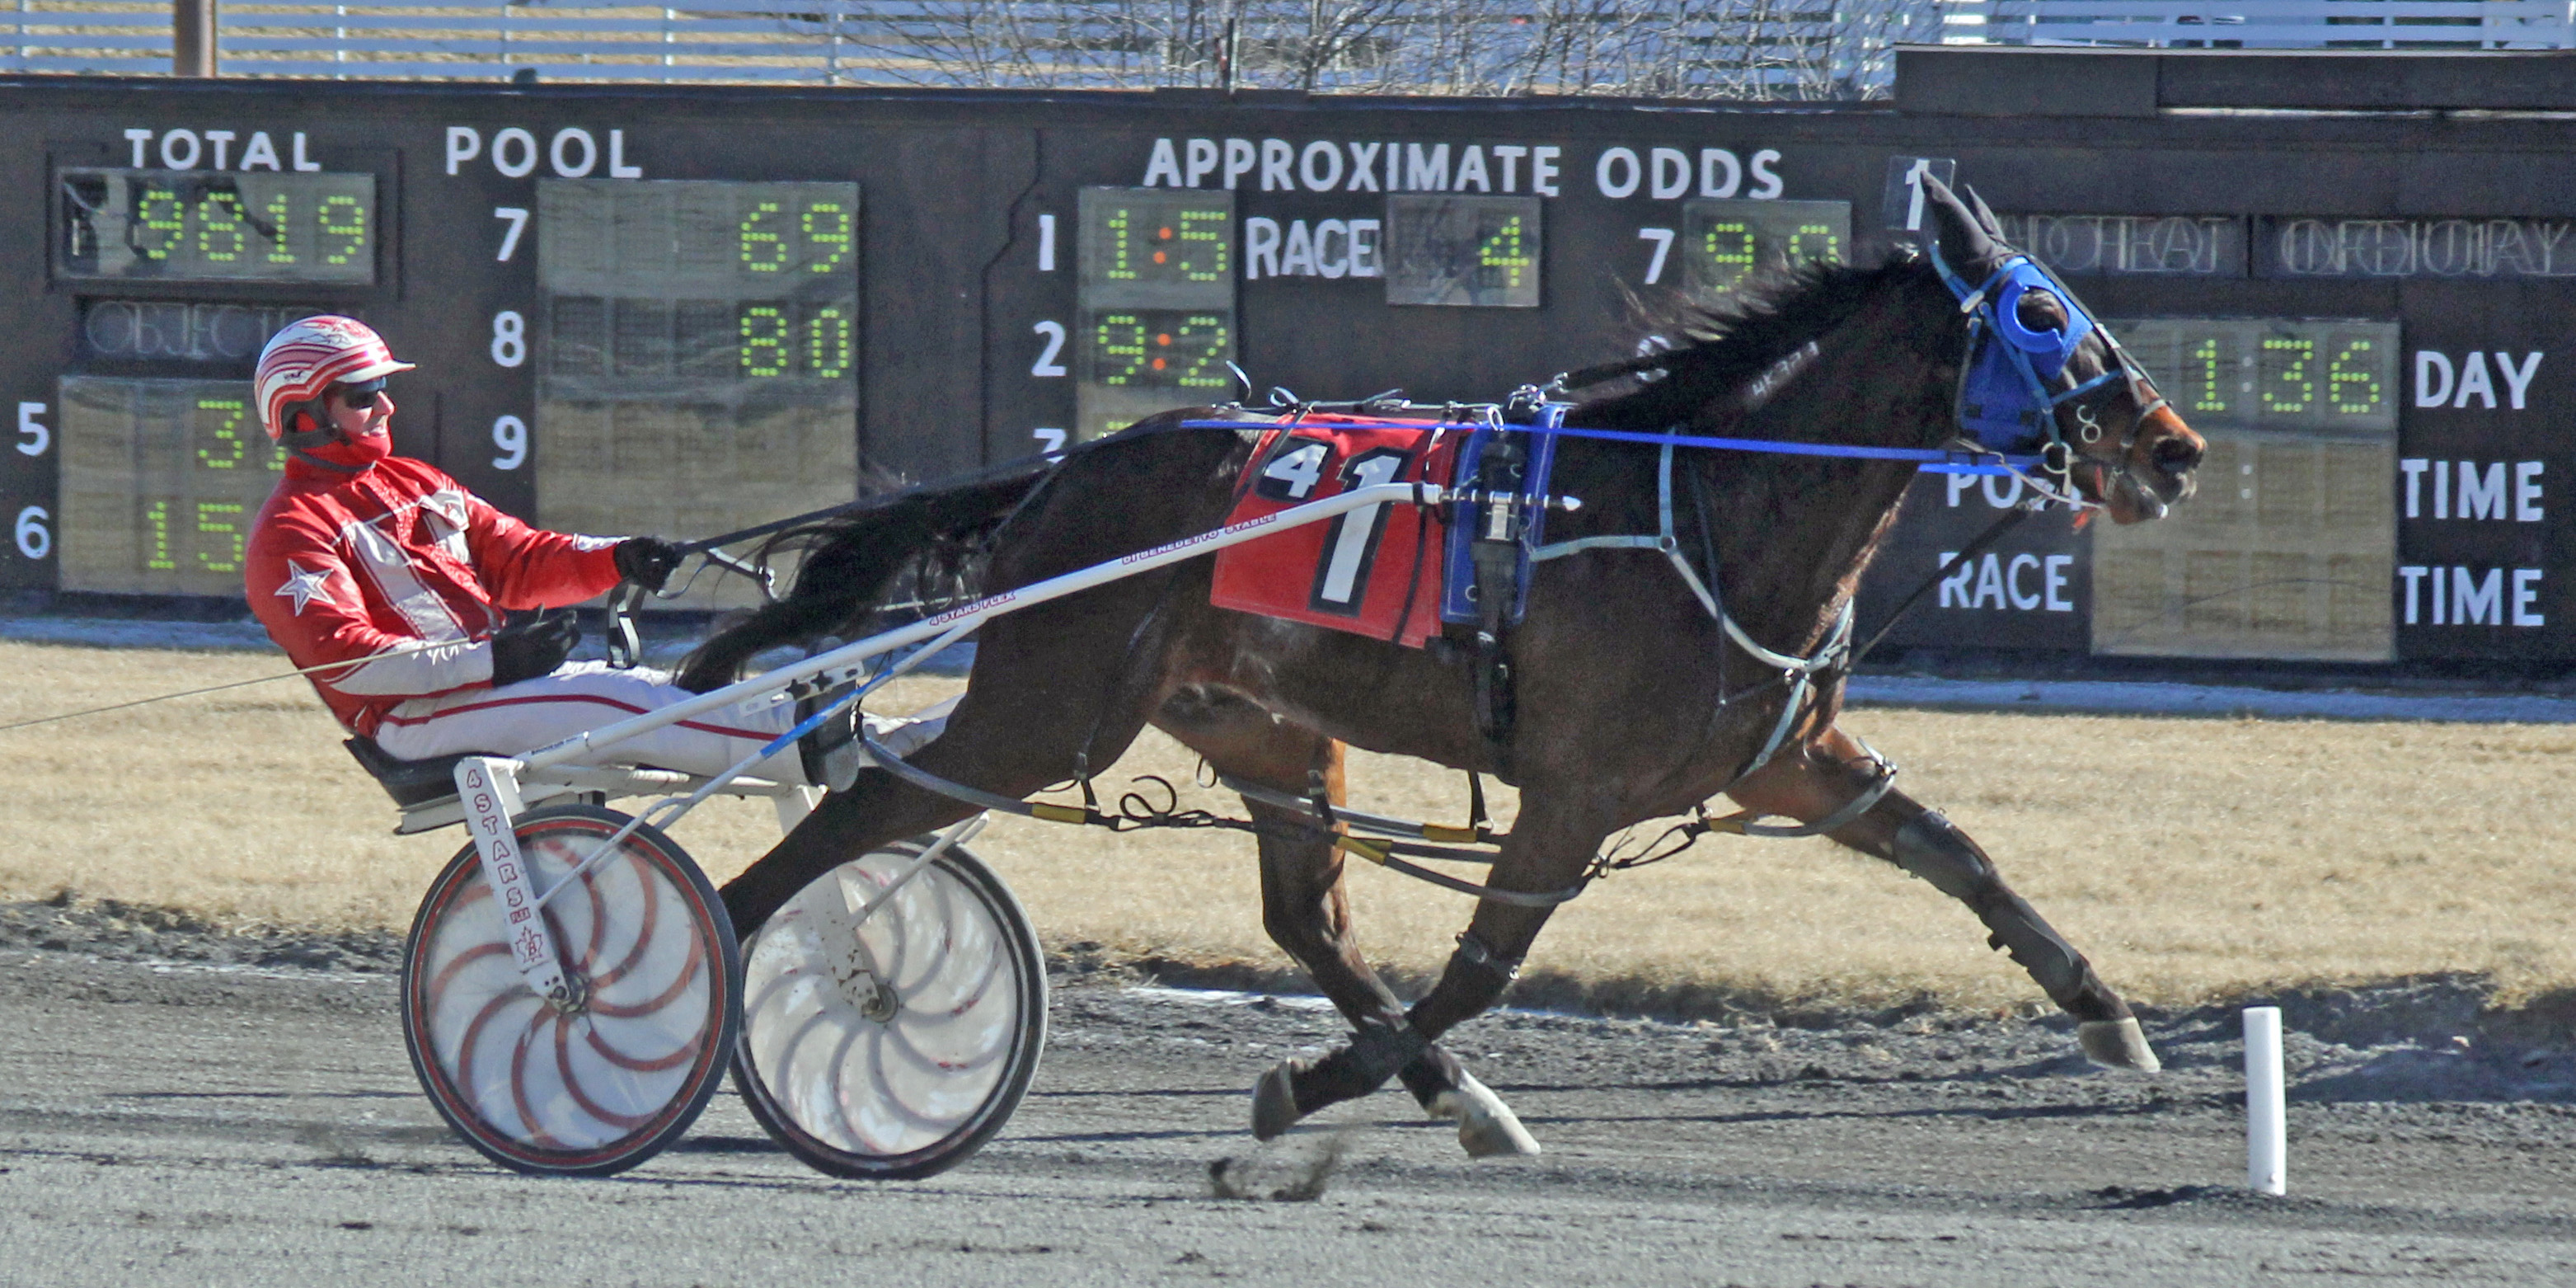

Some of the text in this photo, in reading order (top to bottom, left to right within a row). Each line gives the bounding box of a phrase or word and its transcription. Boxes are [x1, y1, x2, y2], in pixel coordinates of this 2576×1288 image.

[124, 126, 643, 179] TOTAL POOL
[1143, 138, 1783, 200] APPROXIMATE ODDS
[1905, 158, 1930, 230] 1
[138, 190, 365, 264] 9819
[495, 207, 529, 261] 7
[740, 203, 850, 273] 69
[1038, 214, 1055, 271] 1
[1108, 209, 1227, 281] 1:5
[1246, 217, 1381, 280] RACE
[1480, 216, 1530, 286] 4
[1639, 228, 1675, 284] 7
[491, 311, 526, 368] 8
[740, 307, 849, 378] 80
[1031, 321, 1066, 377] 2
[1097, 315, 1227, 387] 9:2
[2196, 339, 2380, 413] 1:36
[2415, 350, 2544, 410] DAY
[16, 402, 49, 456] 5
[493, 416, 528, 471] 9
[2400, 458, 2544, 523] TIME
[15, 505, 49, 560] 6
[1263, 444, 1402, 603] 4 1
[1939, 552, 2074, 613] RACE
[2400, 566, 2544, 628] TIME
